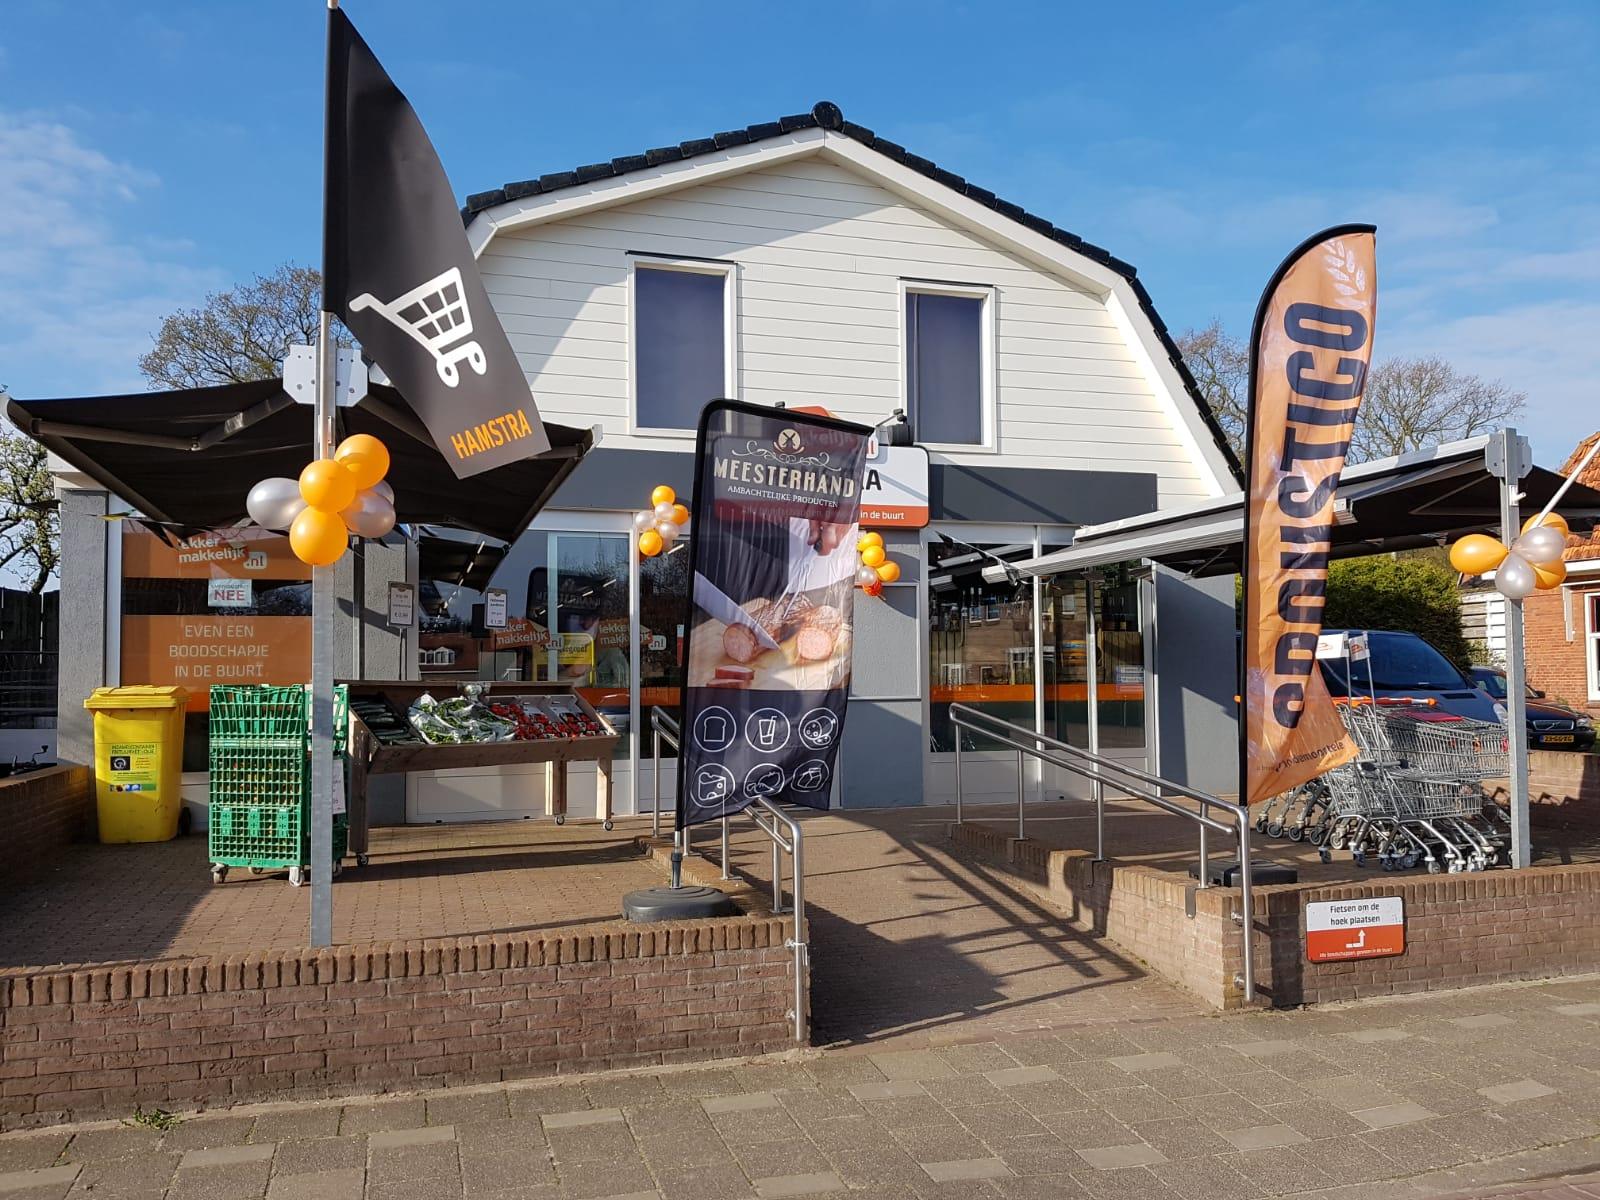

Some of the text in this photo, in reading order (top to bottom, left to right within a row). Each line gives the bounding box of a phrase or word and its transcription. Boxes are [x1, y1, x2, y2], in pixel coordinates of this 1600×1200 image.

[450, 409, 533, 459] HAMSTRA
[713, 456, 856, 498] MEESTERHAND
[727, 485, 838, 508] AMBACHTELIJKE PRODUCTEN
[860, 511, 904, 520] in de buurt
[179, 537, 220, 550] ekker
[179, 547, 246, 563] makkelijk
[246, 555, 264, 567] .nl
[214, 589, 246, 601] NEE
[185, 625, 254, 638] EVEN EEN
[169, 645, 269, 657] BOODSCHAPJE
[175, 664, 265, 678] IN DE BUURT
[1330, 904, 1356, 913] Fietsen
[1330, 915, 1380, 925] hoek plaatsen
